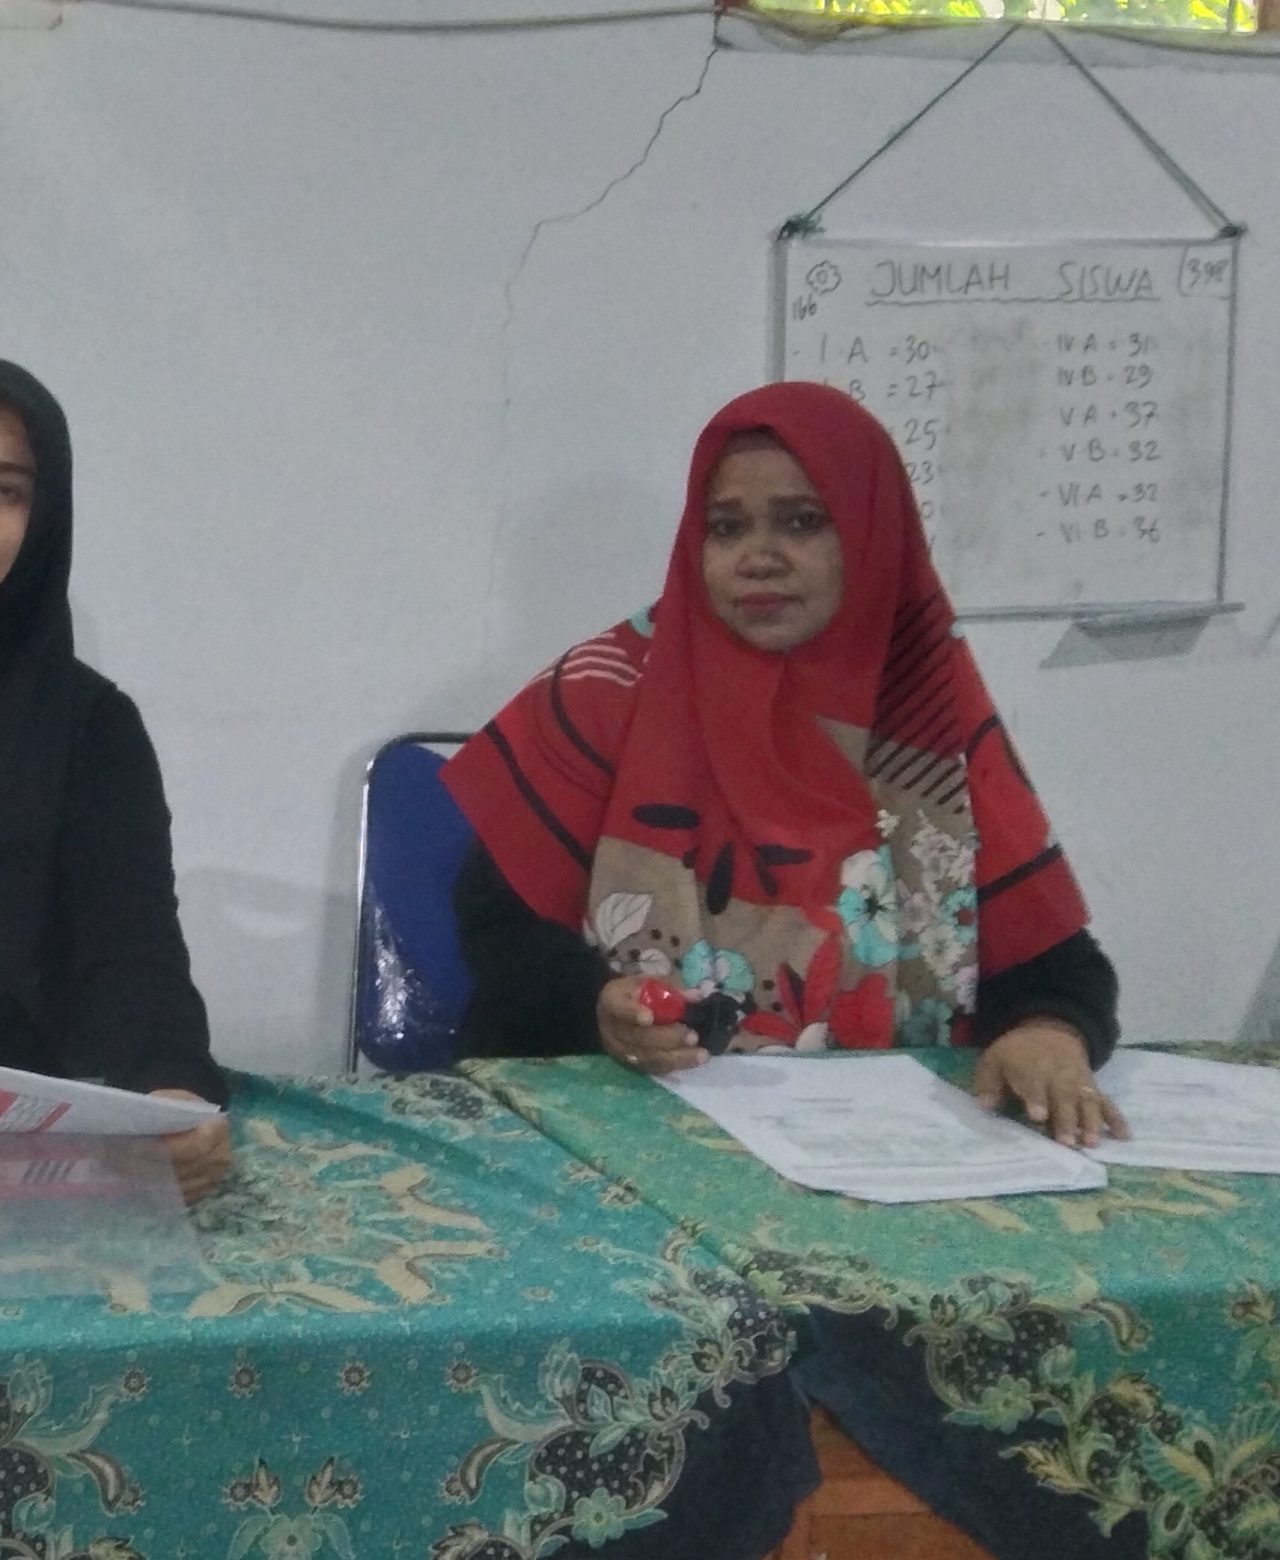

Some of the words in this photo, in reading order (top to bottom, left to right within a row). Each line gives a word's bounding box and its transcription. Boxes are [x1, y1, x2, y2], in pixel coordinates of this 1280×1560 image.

[870, 258, 1010, 298] JUMLAH
[1057, 259, 1154, 299] SISWA
[847, 335, 869, 365] A
[903, 417, 940, 452] 25
